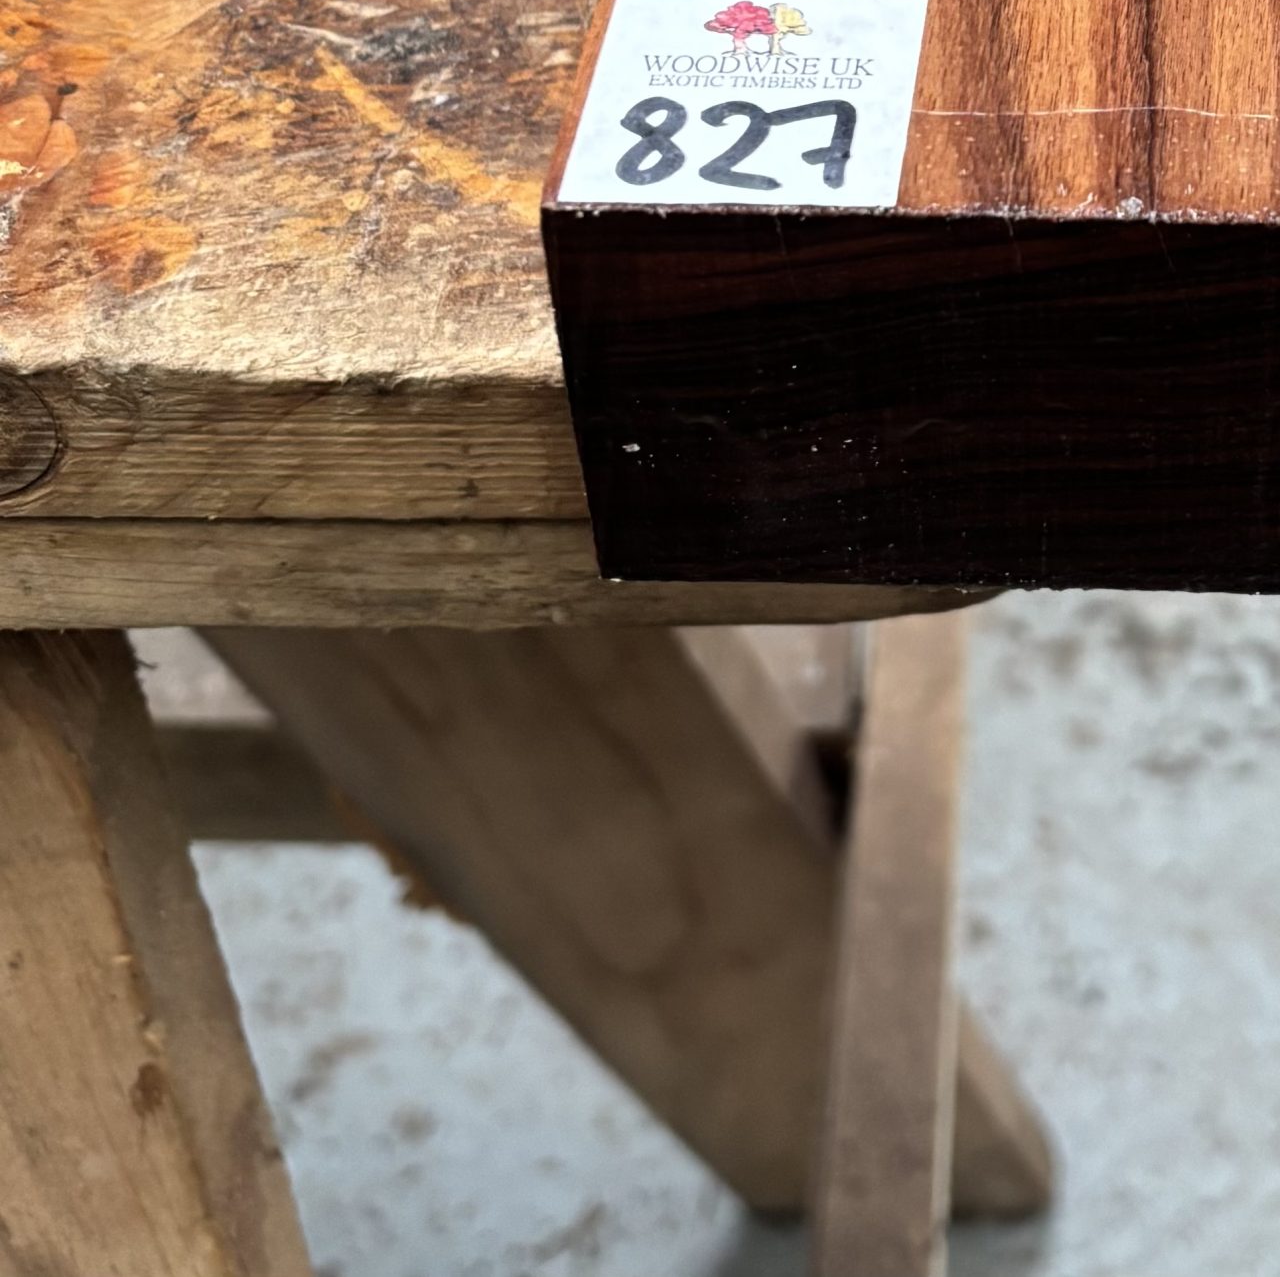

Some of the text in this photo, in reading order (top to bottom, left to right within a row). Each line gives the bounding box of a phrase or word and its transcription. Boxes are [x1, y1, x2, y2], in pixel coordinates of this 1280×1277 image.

[643, 54, 875, 77] WOODWISE UK
[648, 74, 863, 90] EXOTIC TIMBERS LTD
[615, 96, 857, 191] 827
